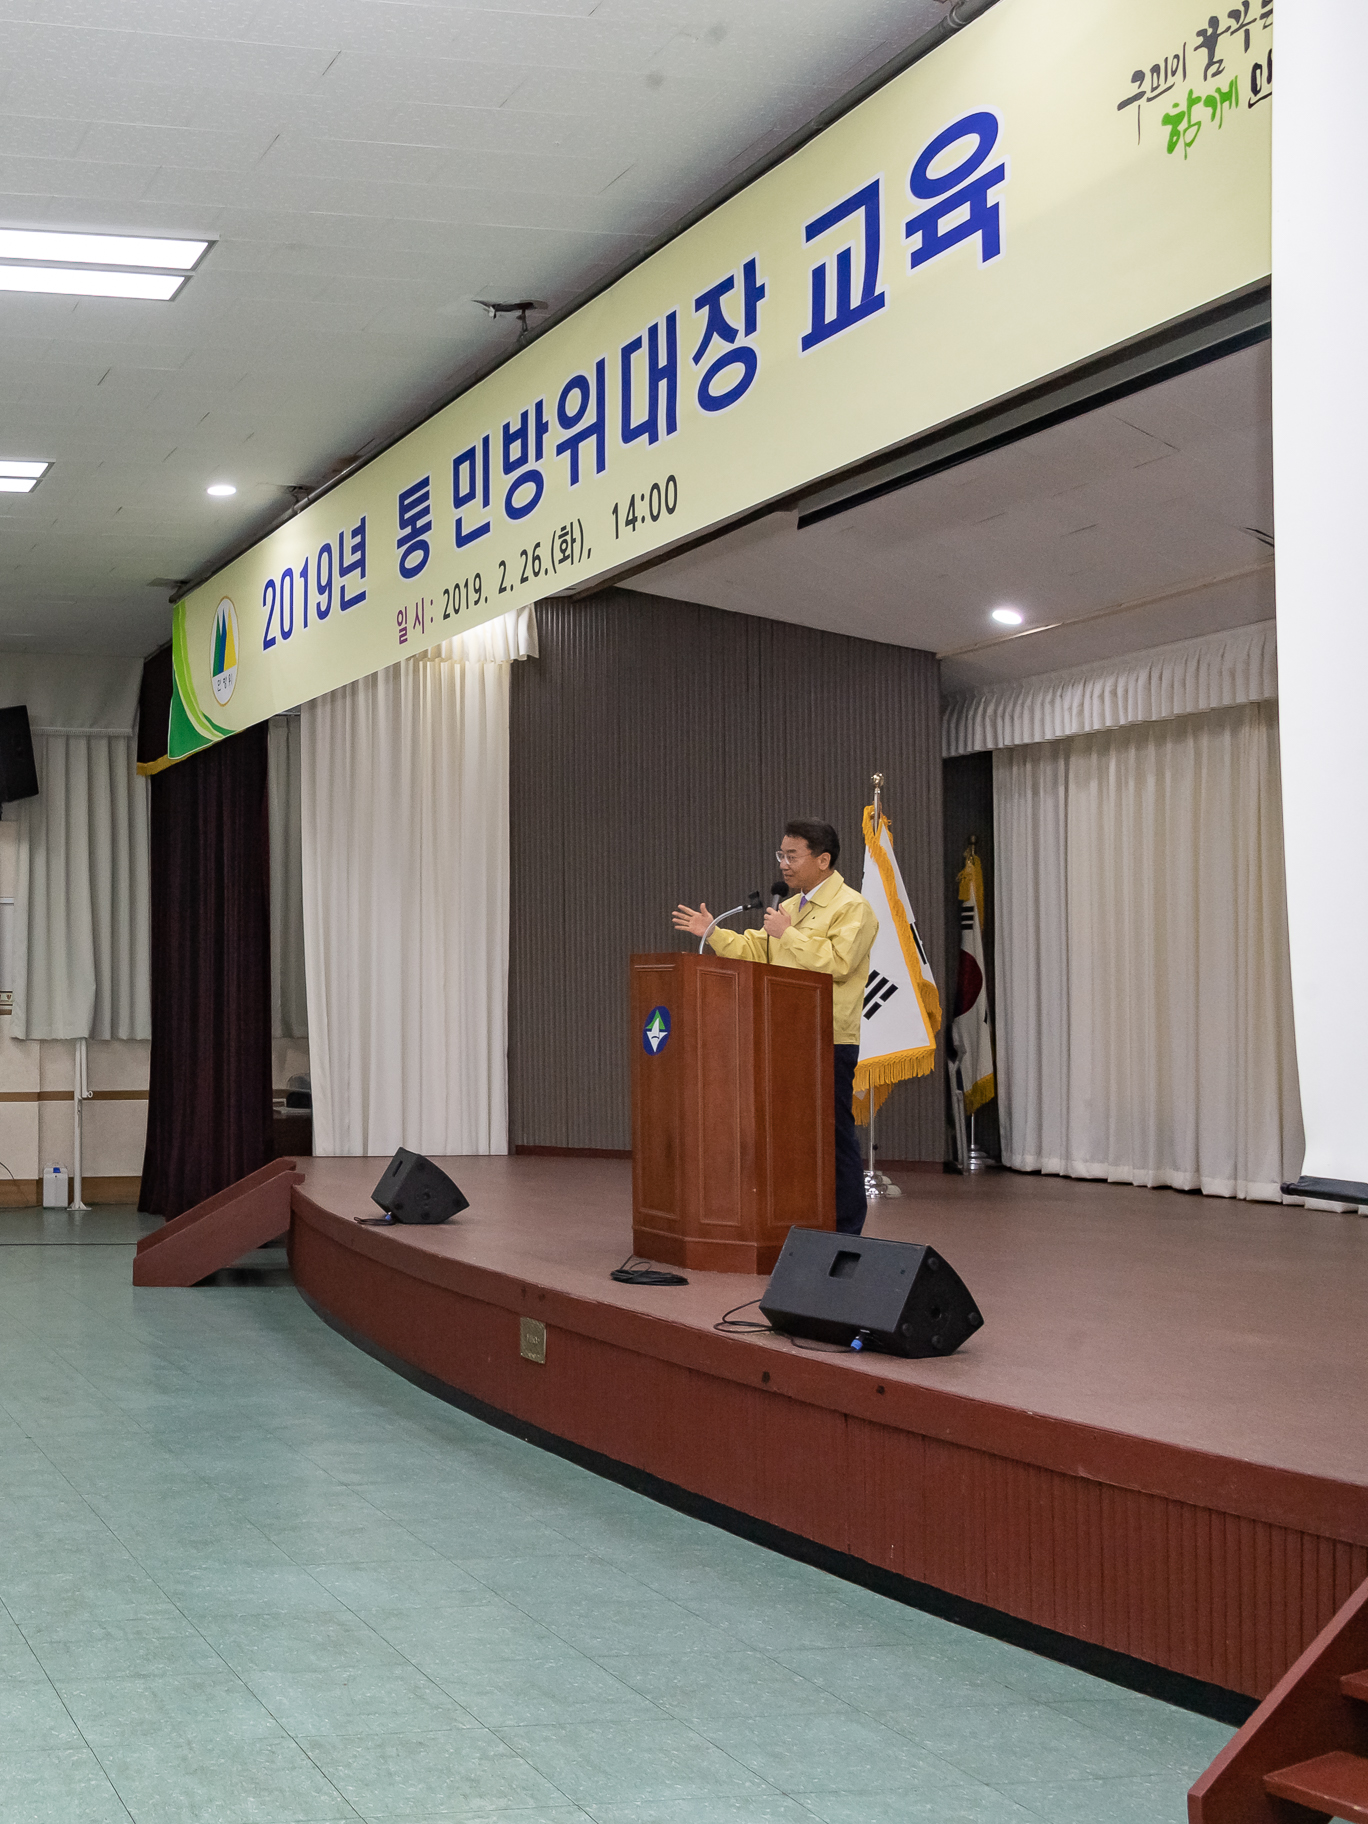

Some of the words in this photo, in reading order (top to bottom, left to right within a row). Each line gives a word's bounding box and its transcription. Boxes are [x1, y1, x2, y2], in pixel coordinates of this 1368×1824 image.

[1117, 41, 1187, 146] 구민이
[1161, 75, 1239, 160] 함께
[262, 515, 367, 652] 2019년
[800, 111, 1006, 353] 교육
[611, 474, 678, 540] 14:00
